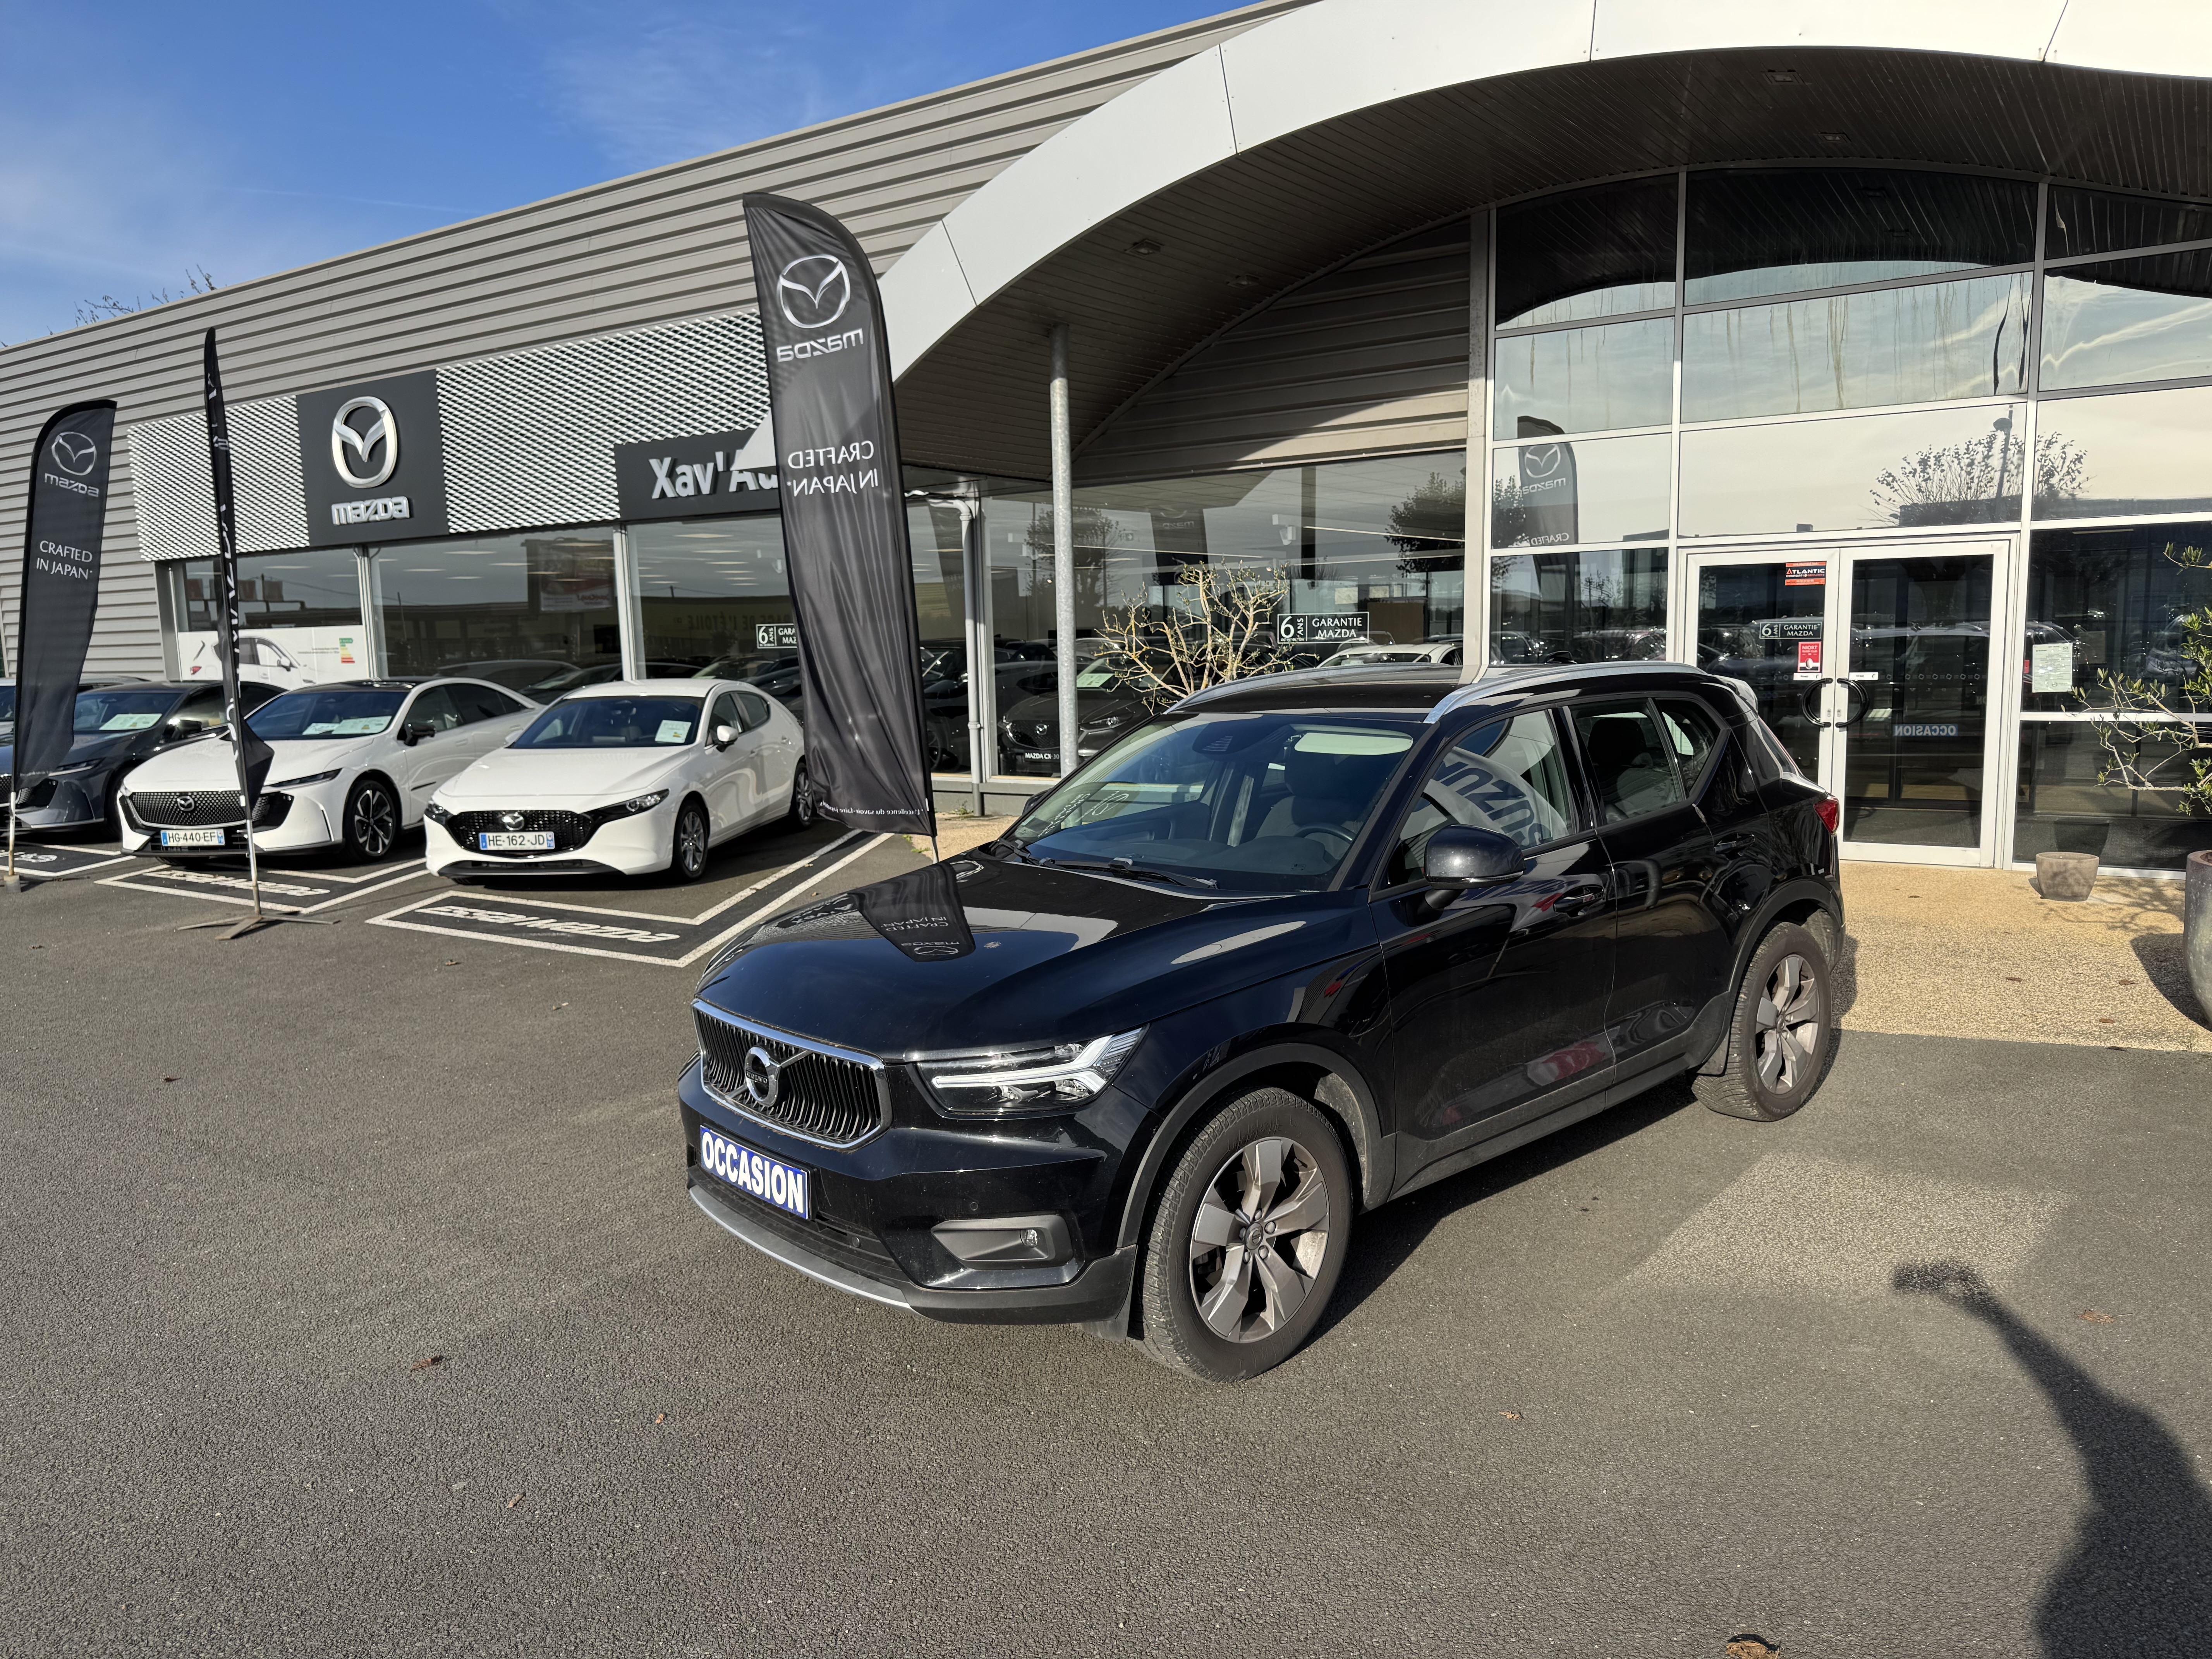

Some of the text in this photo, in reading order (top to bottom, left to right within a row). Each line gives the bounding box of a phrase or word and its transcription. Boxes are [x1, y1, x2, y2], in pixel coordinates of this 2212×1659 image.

[649, 451, 723, 499] Xav'
[45, 473, 99, 498] mazda
[331, 496, 410, 525] mazda
[40, 540, 93, 562] CRAFTED
[36, 558, 49, 571] IN
[1280, 616, 1295, 638] 6
[1312, 617, 1362, 627] GARANTIE
[1762, 623, 1772, 636] 6
[759, 626, 768, 644] 6
[1318, 629, 1357, 638] MAZDA
[168, 831, 216, 842] HG-440-EF
[488, 835, 545, 846] HE-162-JD
[702, 1132, 804, 1214] OCCASION
